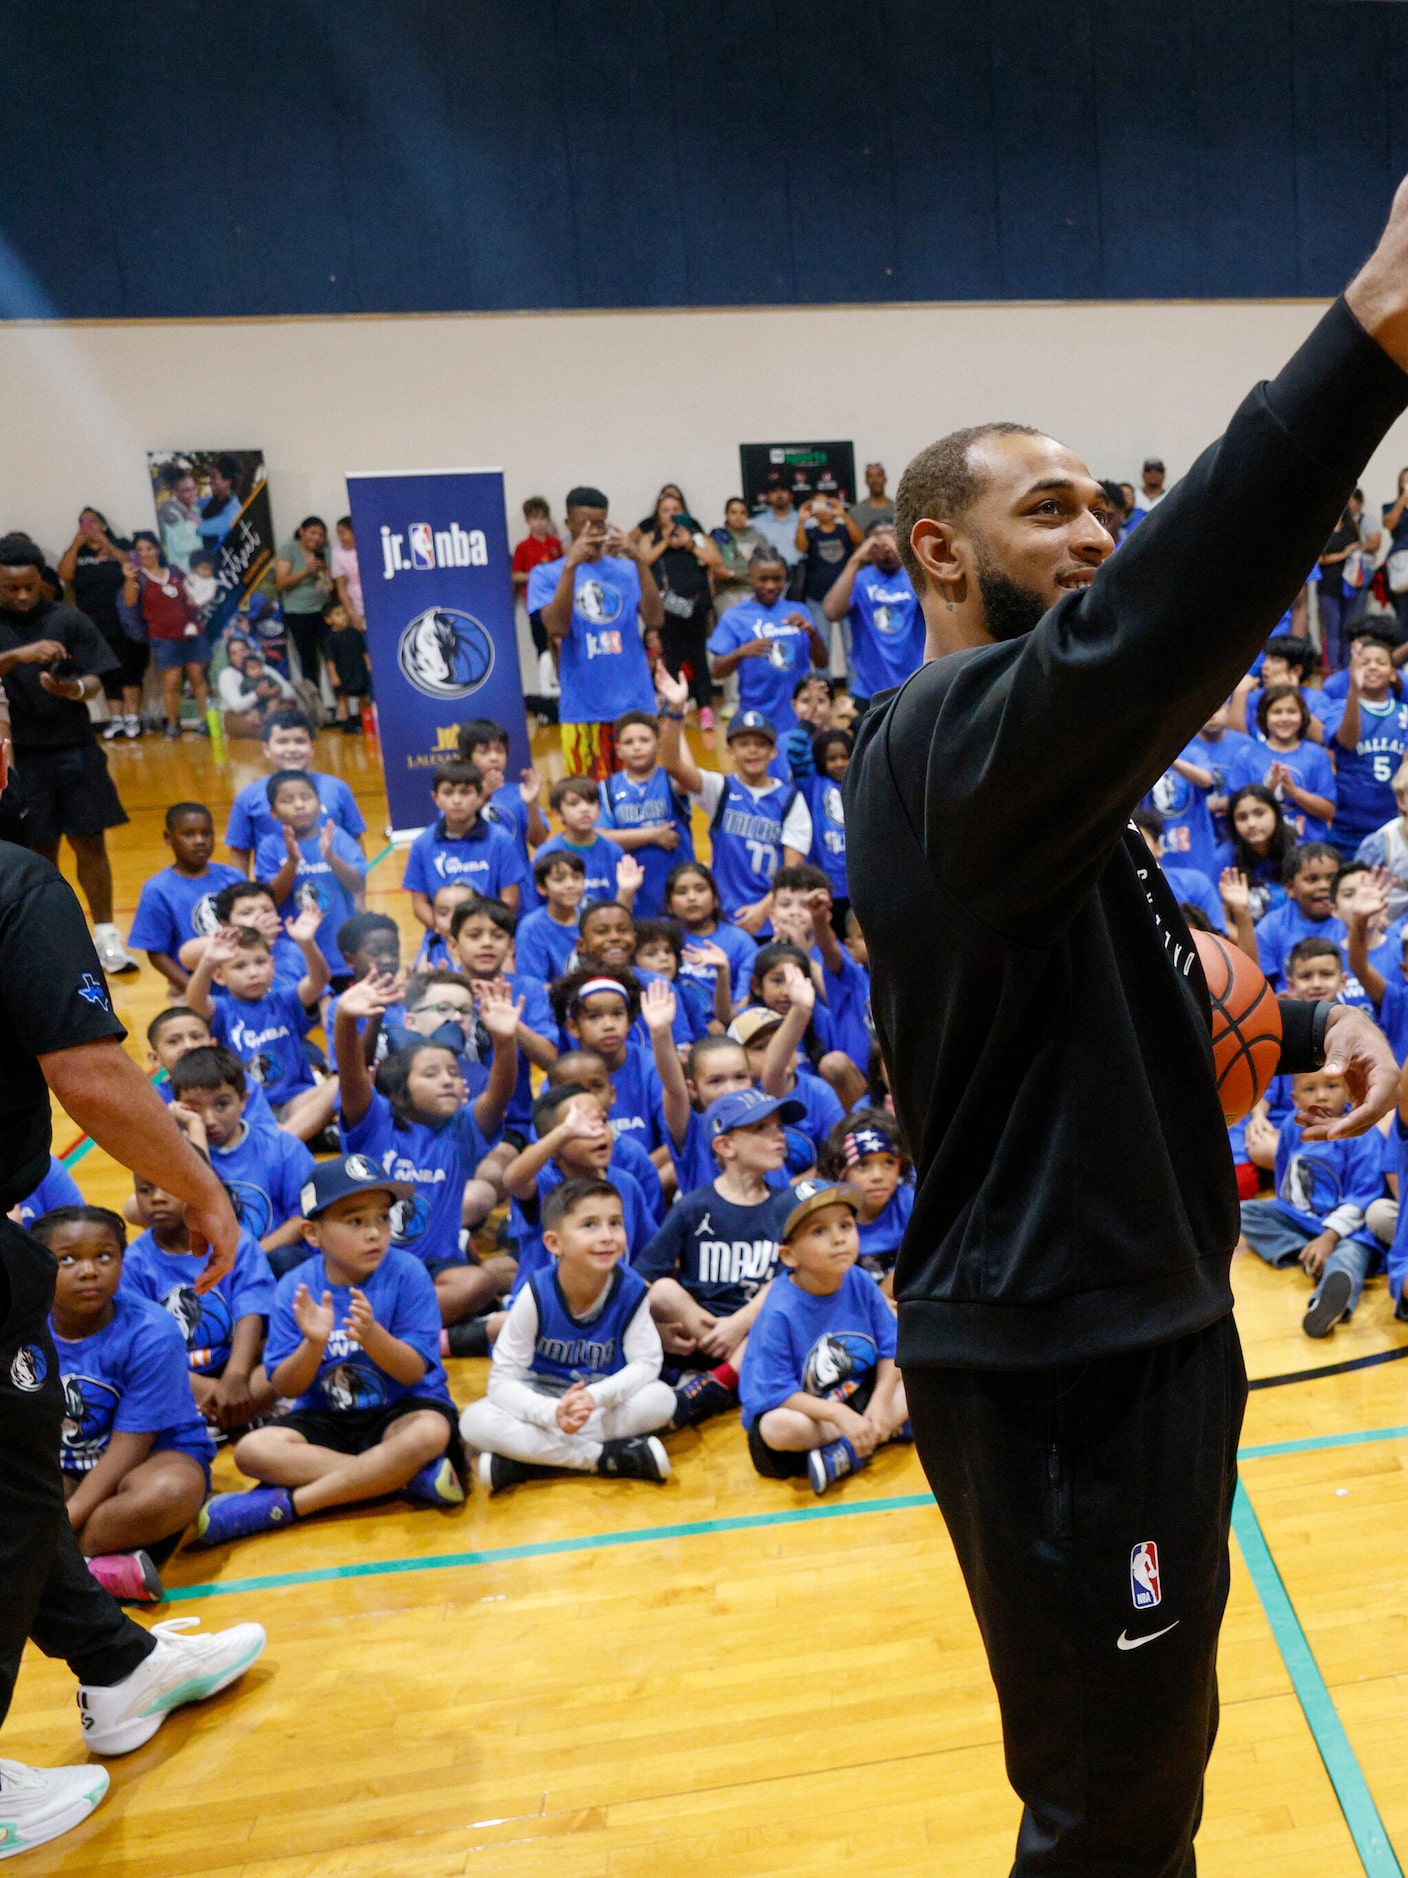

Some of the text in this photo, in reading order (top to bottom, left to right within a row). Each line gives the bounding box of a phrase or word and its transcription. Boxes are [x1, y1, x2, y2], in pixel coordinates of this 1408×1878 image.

[380, 522, 488, 580] jr. nba
[1356, 737, 1405, 755] DALLAS
[1373, 754, 1391, 782] 5
